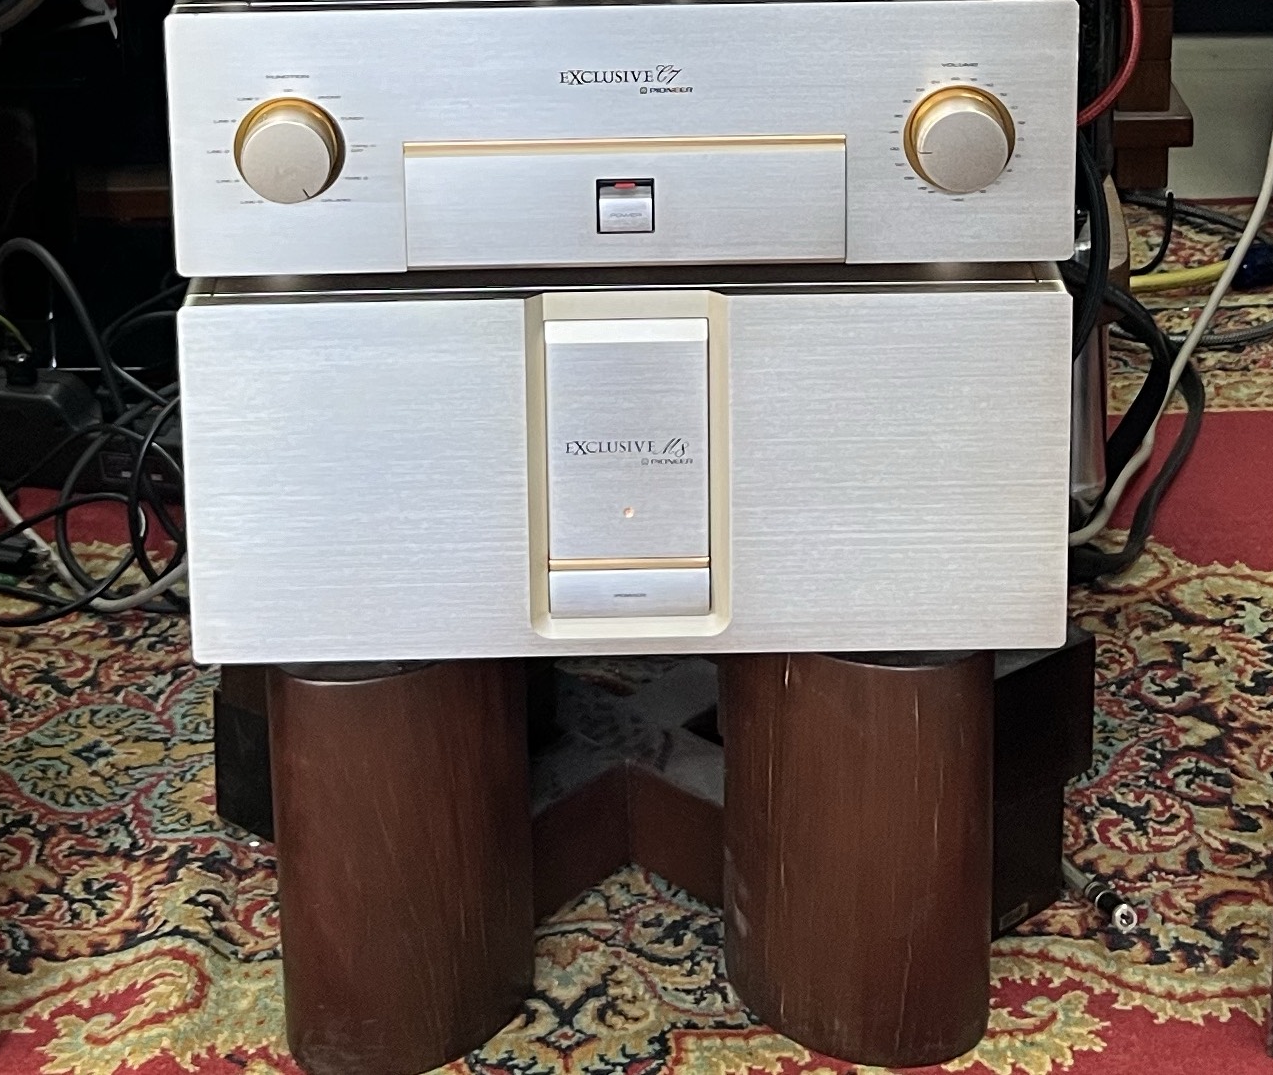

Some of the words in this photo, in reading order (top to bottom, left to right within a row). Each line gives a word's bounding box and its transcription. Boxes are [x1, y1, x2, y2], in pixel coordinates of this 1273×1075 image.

[559, 69, 654, 86] EXCLUSIVE
[649, 86, 694, 94] PIONEER
[565, 440, 655, 456] EXCLUSIVE
